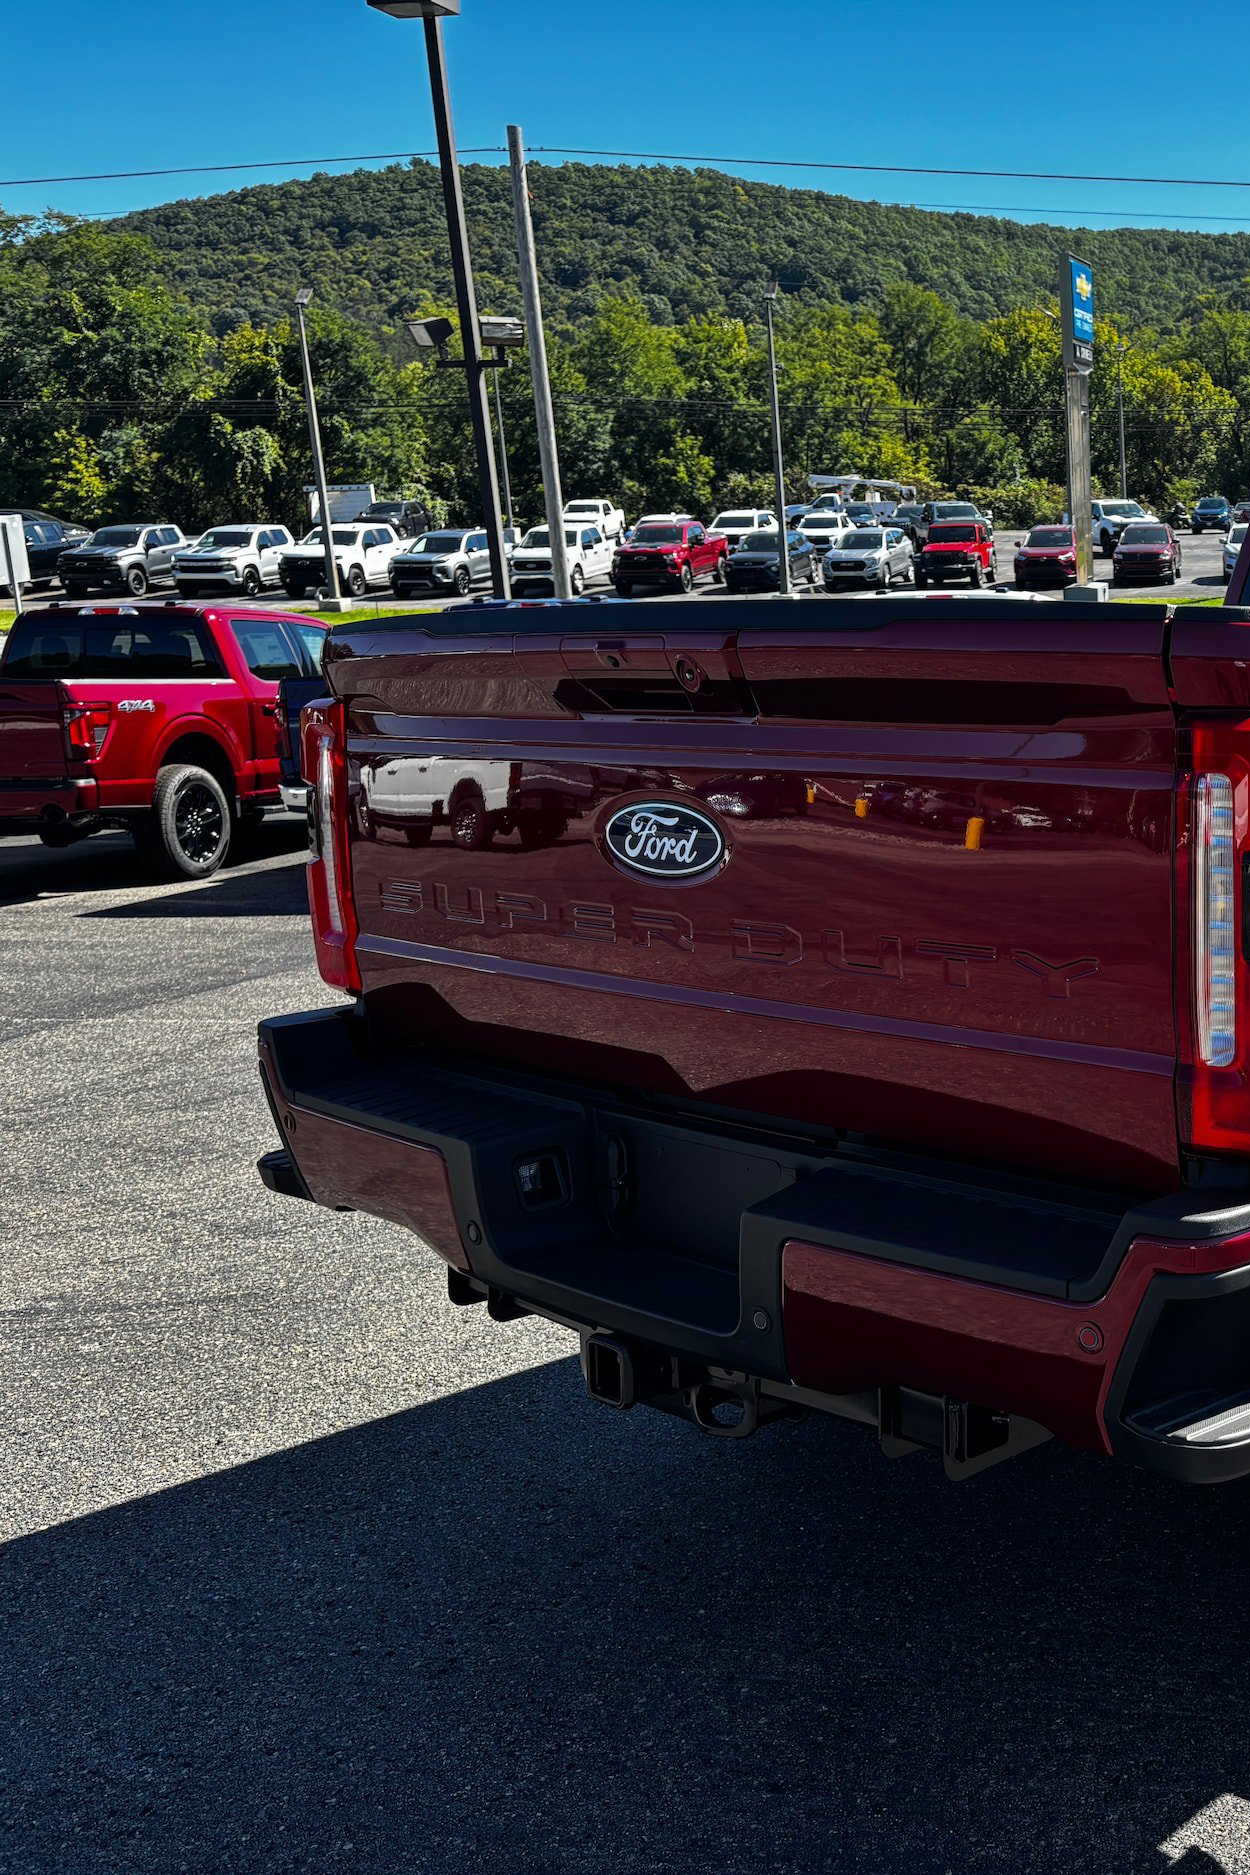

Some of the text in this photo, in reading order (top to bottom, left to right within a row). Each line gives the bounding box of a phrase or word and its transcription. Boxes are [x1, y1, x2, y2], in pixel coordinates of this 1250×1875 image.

[625, 812, 698, 863] Ford
[379, 877, 1099, 999] SUPER DUTY
